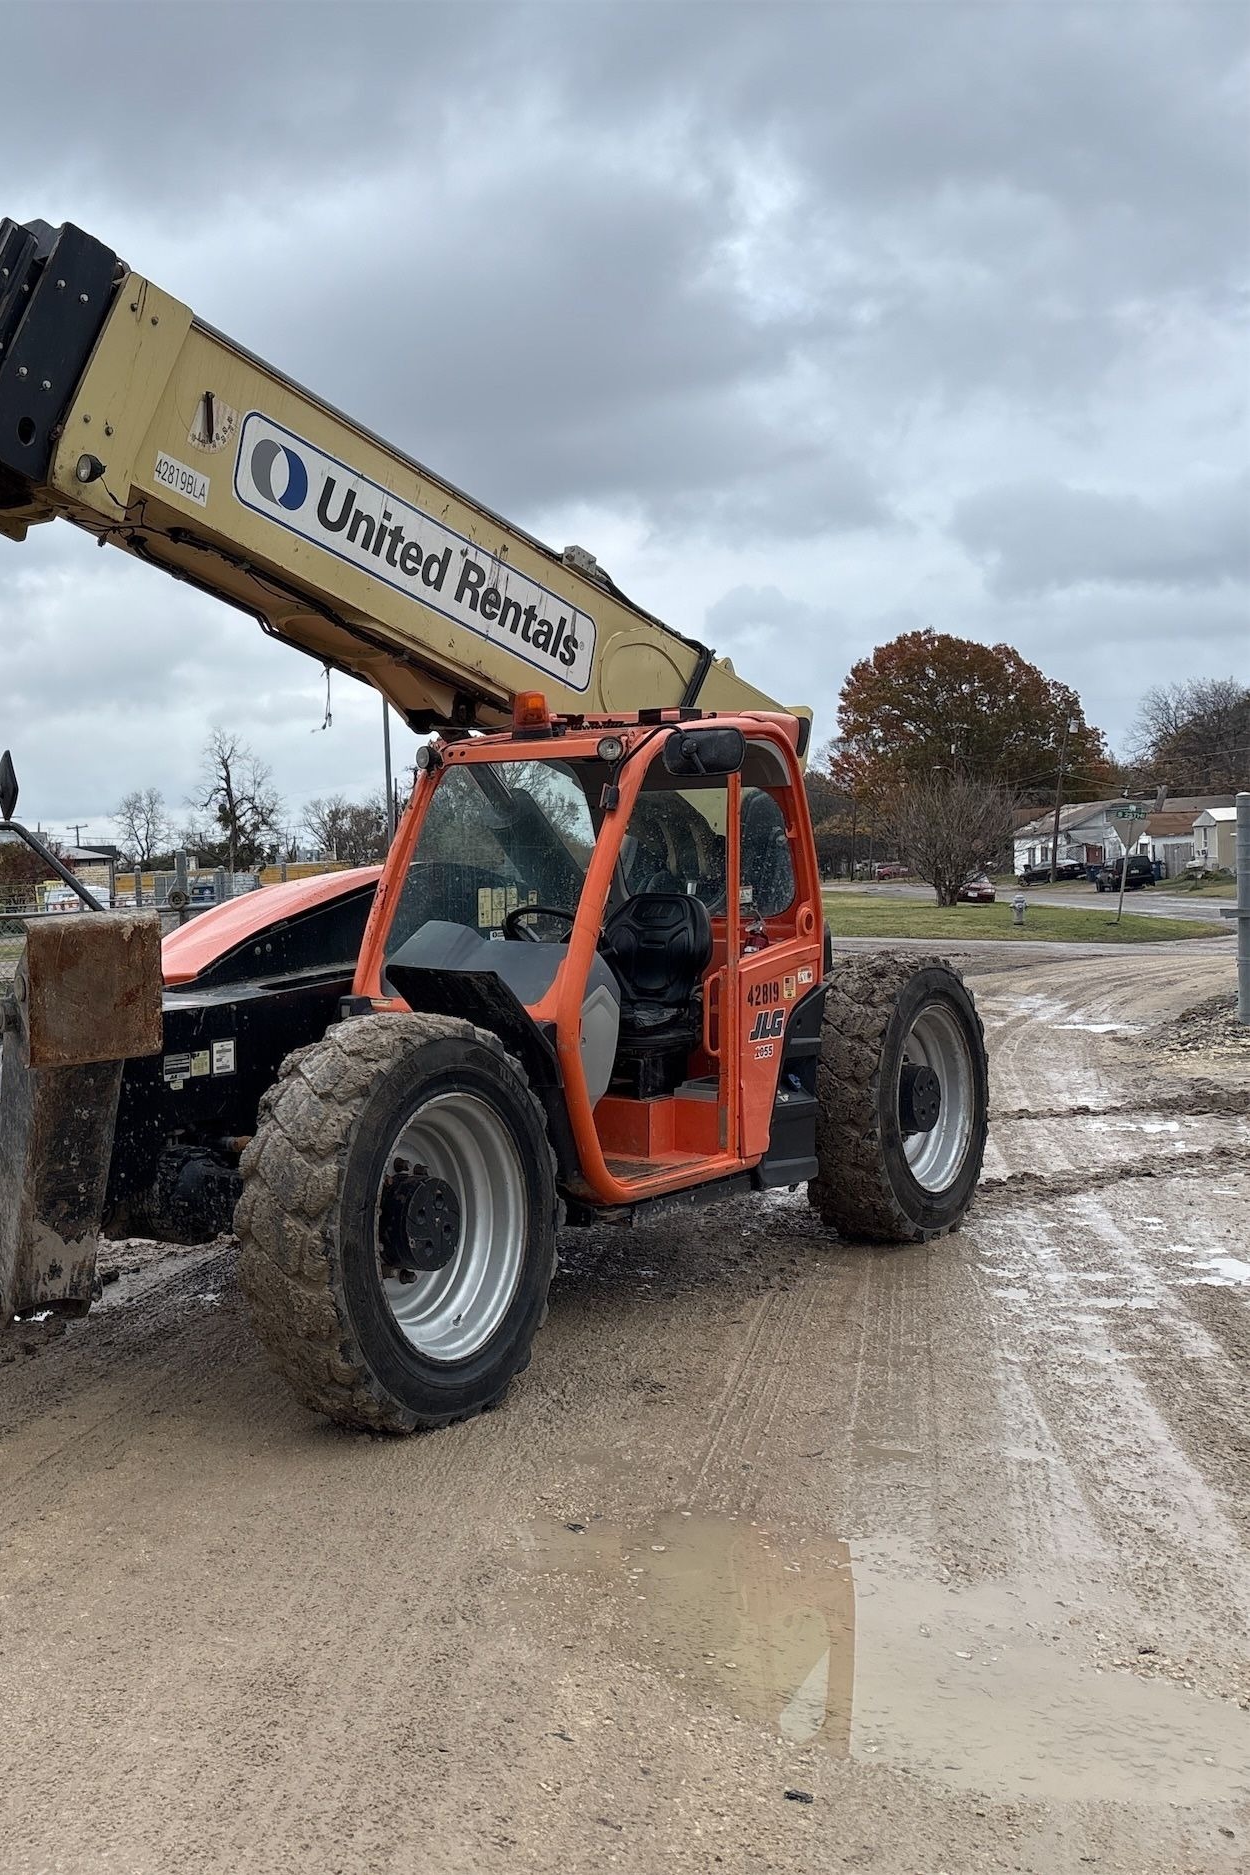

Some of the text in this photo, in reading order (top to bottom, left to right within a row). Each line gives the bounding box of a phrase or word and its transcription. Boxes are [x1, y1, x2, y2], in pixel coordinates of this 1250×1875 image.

[155, 459, 206, 503] 42819BLA
[316, 476, 579, 667] United Rentals
[747, 981, 779, 1007] 42819
[749, 1008, 785, 1042] JLG
